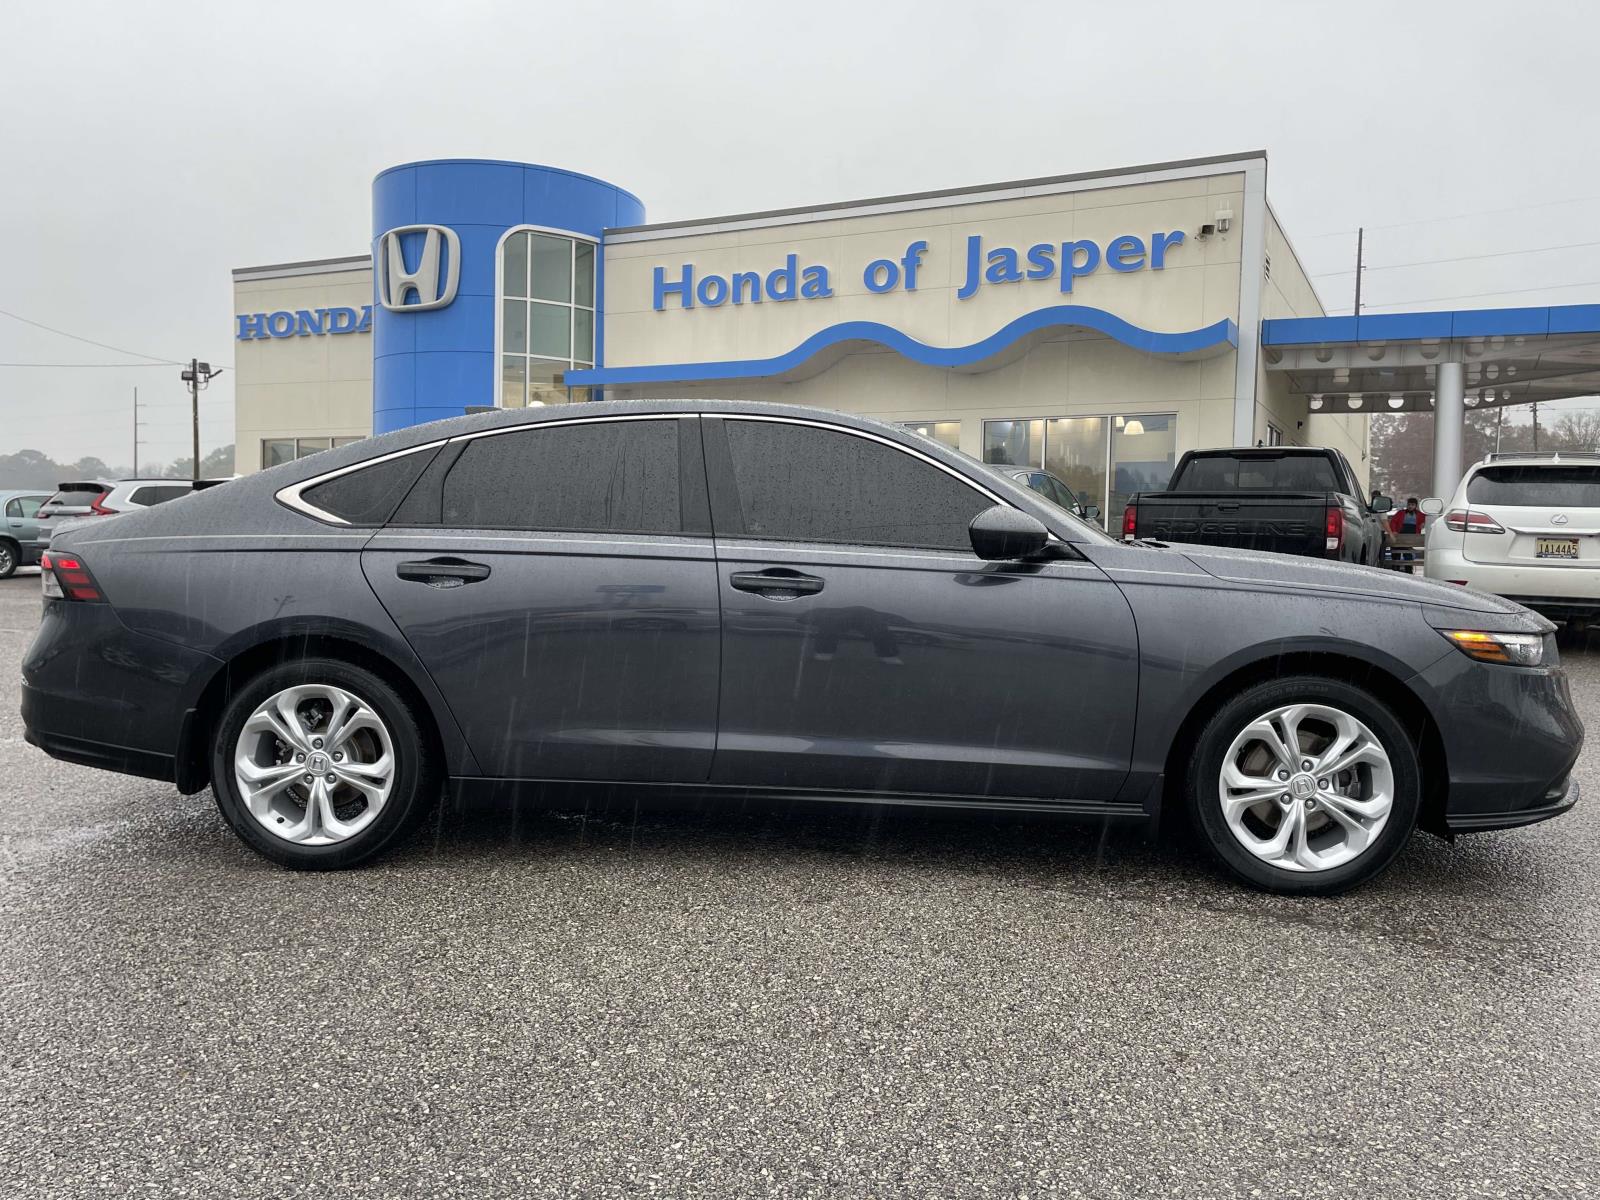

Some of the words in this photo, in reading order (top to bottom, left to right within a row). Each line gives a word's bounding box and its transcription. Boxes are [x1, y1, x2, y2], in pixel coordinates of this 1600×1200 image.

[653, 254, 833, 311] Honda
[863, 240, 928, 294] of
[957, 230, 1185, 300] Jasper
[1153, 520, 1306, 536] RIDGELINE
